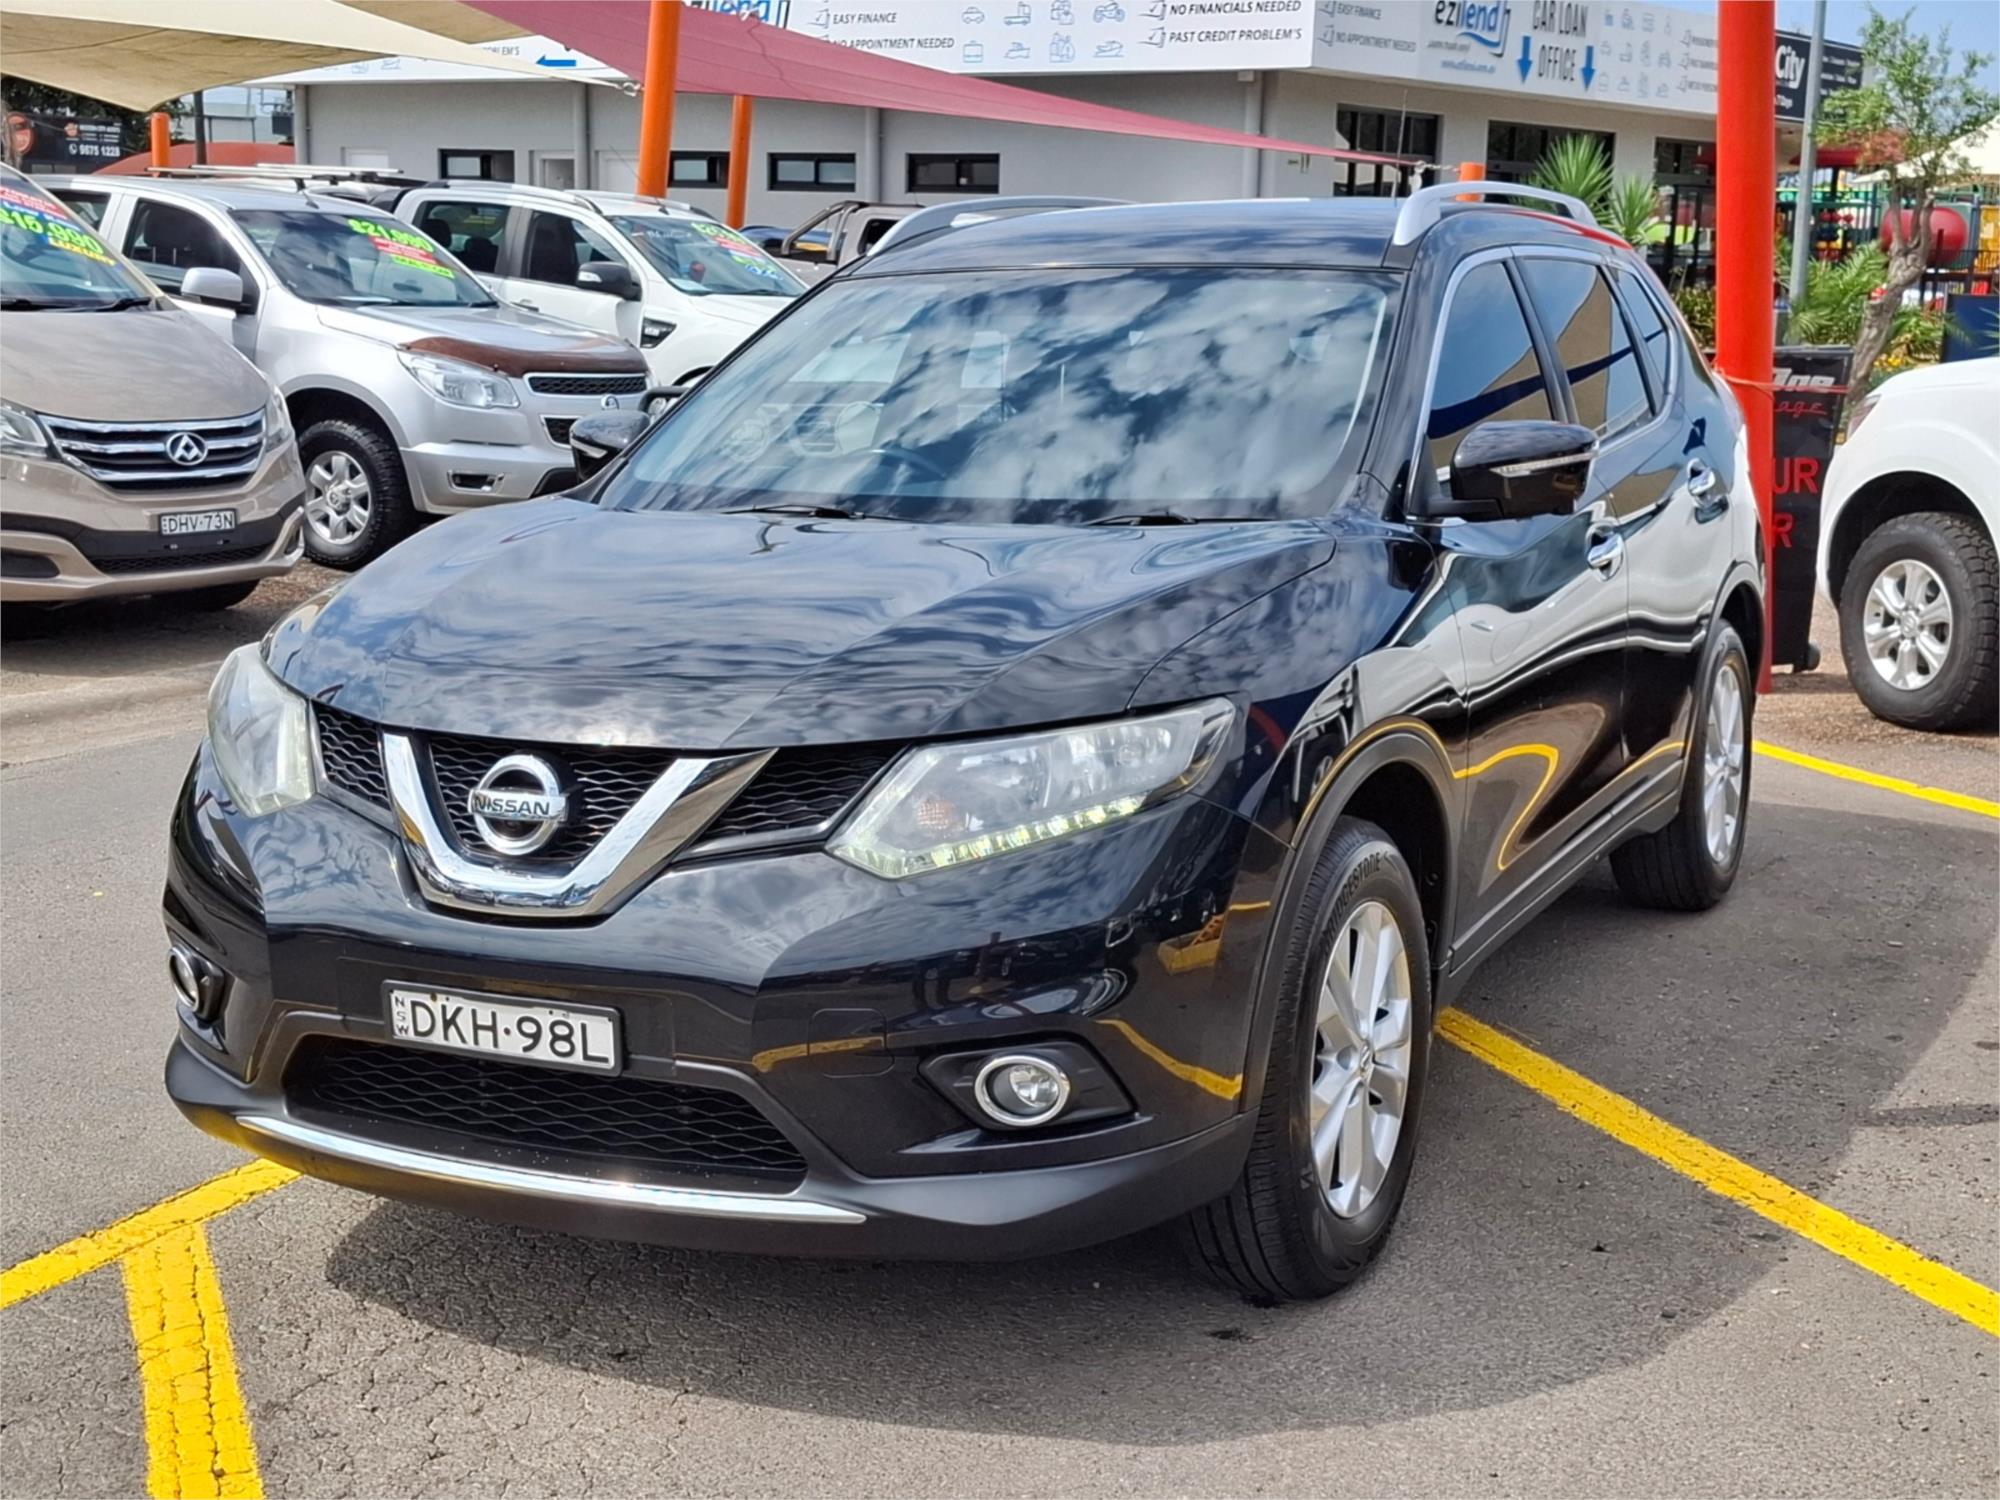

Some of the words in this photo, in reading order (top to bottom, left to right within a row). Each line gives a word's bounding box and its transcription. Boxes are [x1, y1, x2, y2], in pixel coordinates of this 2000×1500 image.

[1169, 4, 1187, 16] NO
[1189, 0, 1252, 15] FINANCIALS
[1255, 0, 1301, 13] NEEDED
[833, 14, 856, 25] EASY
[858, 12, 897, 24] FINANCE
[1532, 0, 1556, 33] CAR
[1559, 1, 1589, 38] LOAN
[849, 38, 915, 49] APPOINTMENT
[916, 37, 955, 48] NEEDED
[1169, 31, 1197, 43] PAST
[1198, 29, 1237, 42] CREDIT
[1239, 28, 1303, 41] PROBLEM'S
[1537, 44, 1577, 82] OFFICE
[1775, 44, 1806, 90] City
[474, 796, 551, 816] NISSAN
